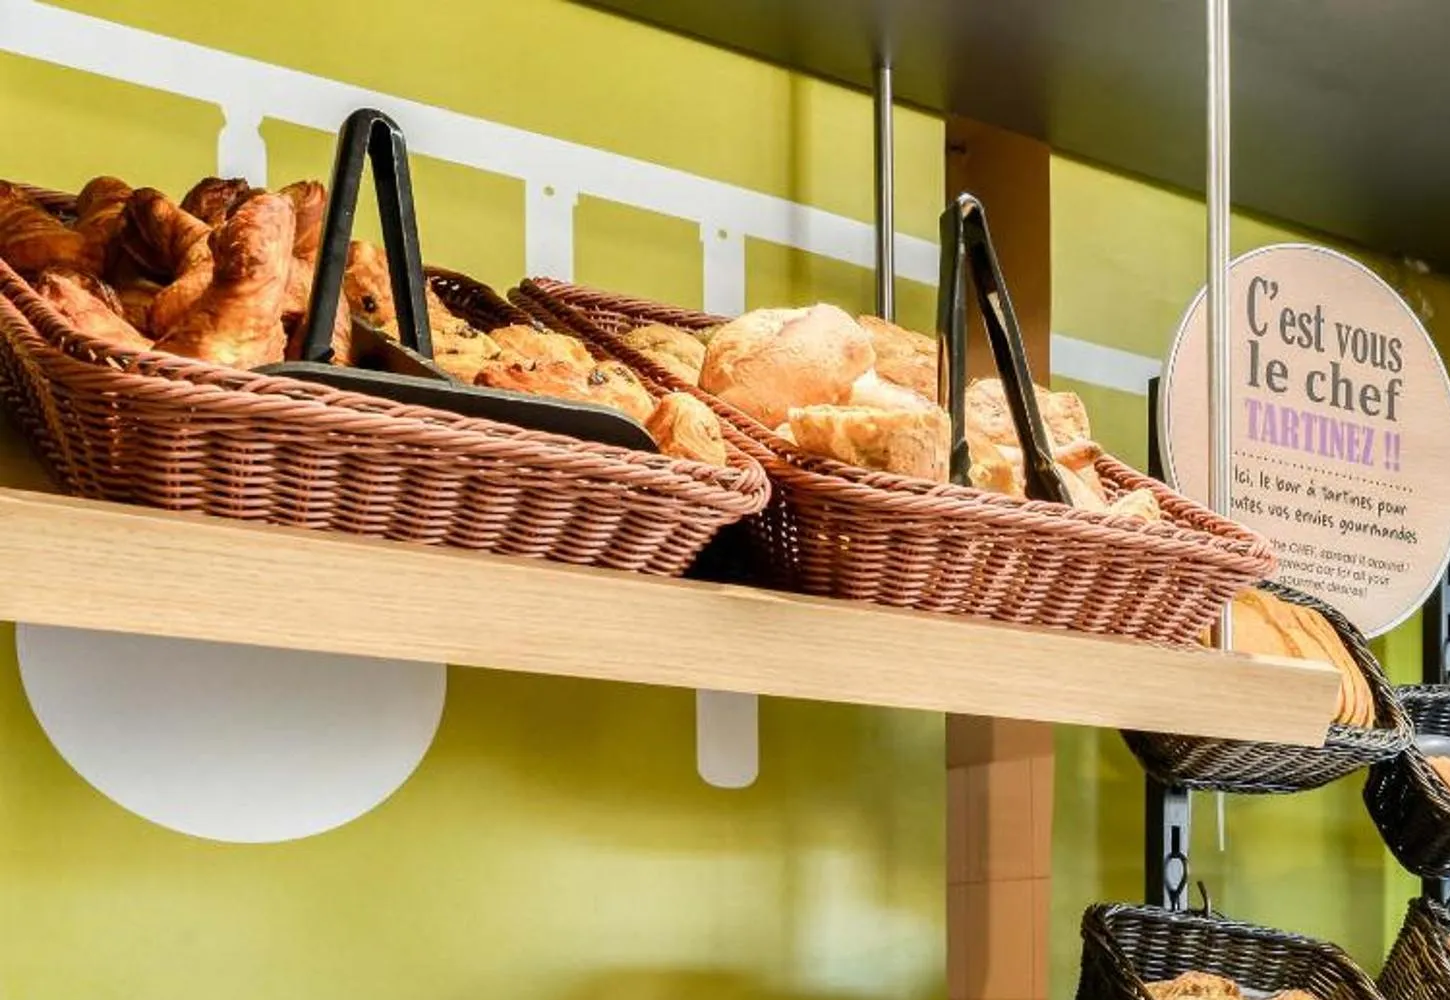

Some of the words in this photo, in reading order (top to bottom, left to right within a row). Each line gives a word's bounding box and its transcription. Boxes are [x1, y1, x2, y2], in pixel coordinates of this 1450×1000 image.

[1246, 275, 1325, 353] C'est
[1334, 322, 1403, 374] vous
[1247, 339, 1289, 393] le
[1306, 360, 1403, 422] chef
[1244, 397, 1375, 467] TARTINEZ
[1384, 431, 1401, 472] !!
[1230, 496, 1263, 514] outes
[1268, 504, 1290, 520] vos
[1295, 509, 1334, 529] envies
[1339, 519, 1418, 545] gourmandes
[1234, 463, 1253, 488] Ici,
[1260, 471, 1270, 490] le
[1320, 486, 1373, 511] tartines
[1377, 501, 1407, 517] pour
